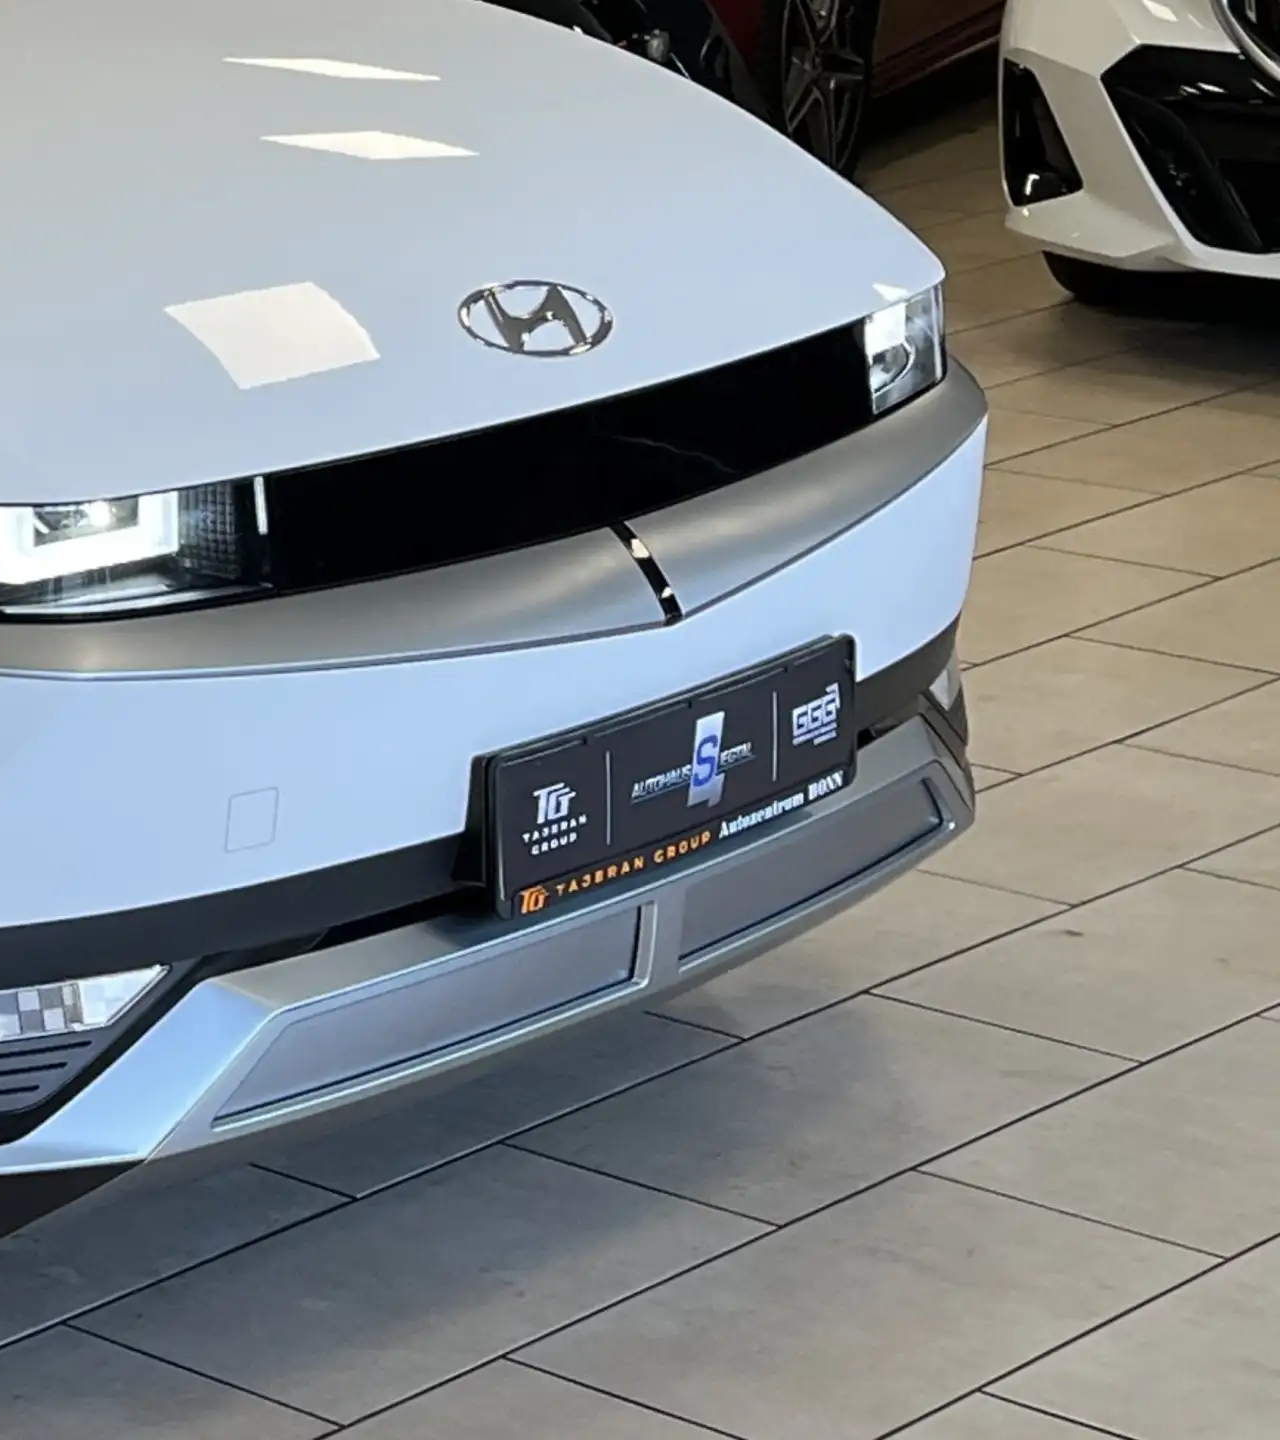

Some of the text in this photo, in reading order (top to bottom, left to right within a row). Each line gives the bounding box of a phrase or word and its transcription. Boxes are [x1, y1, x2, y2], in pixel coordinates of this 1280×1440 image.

[531, 832, 578, 855] GROUP
[556, 857, 645, 896] TAJERAN
[653, 831, 712, 863] GROUP
[807, 770, 844, 800] BONN
